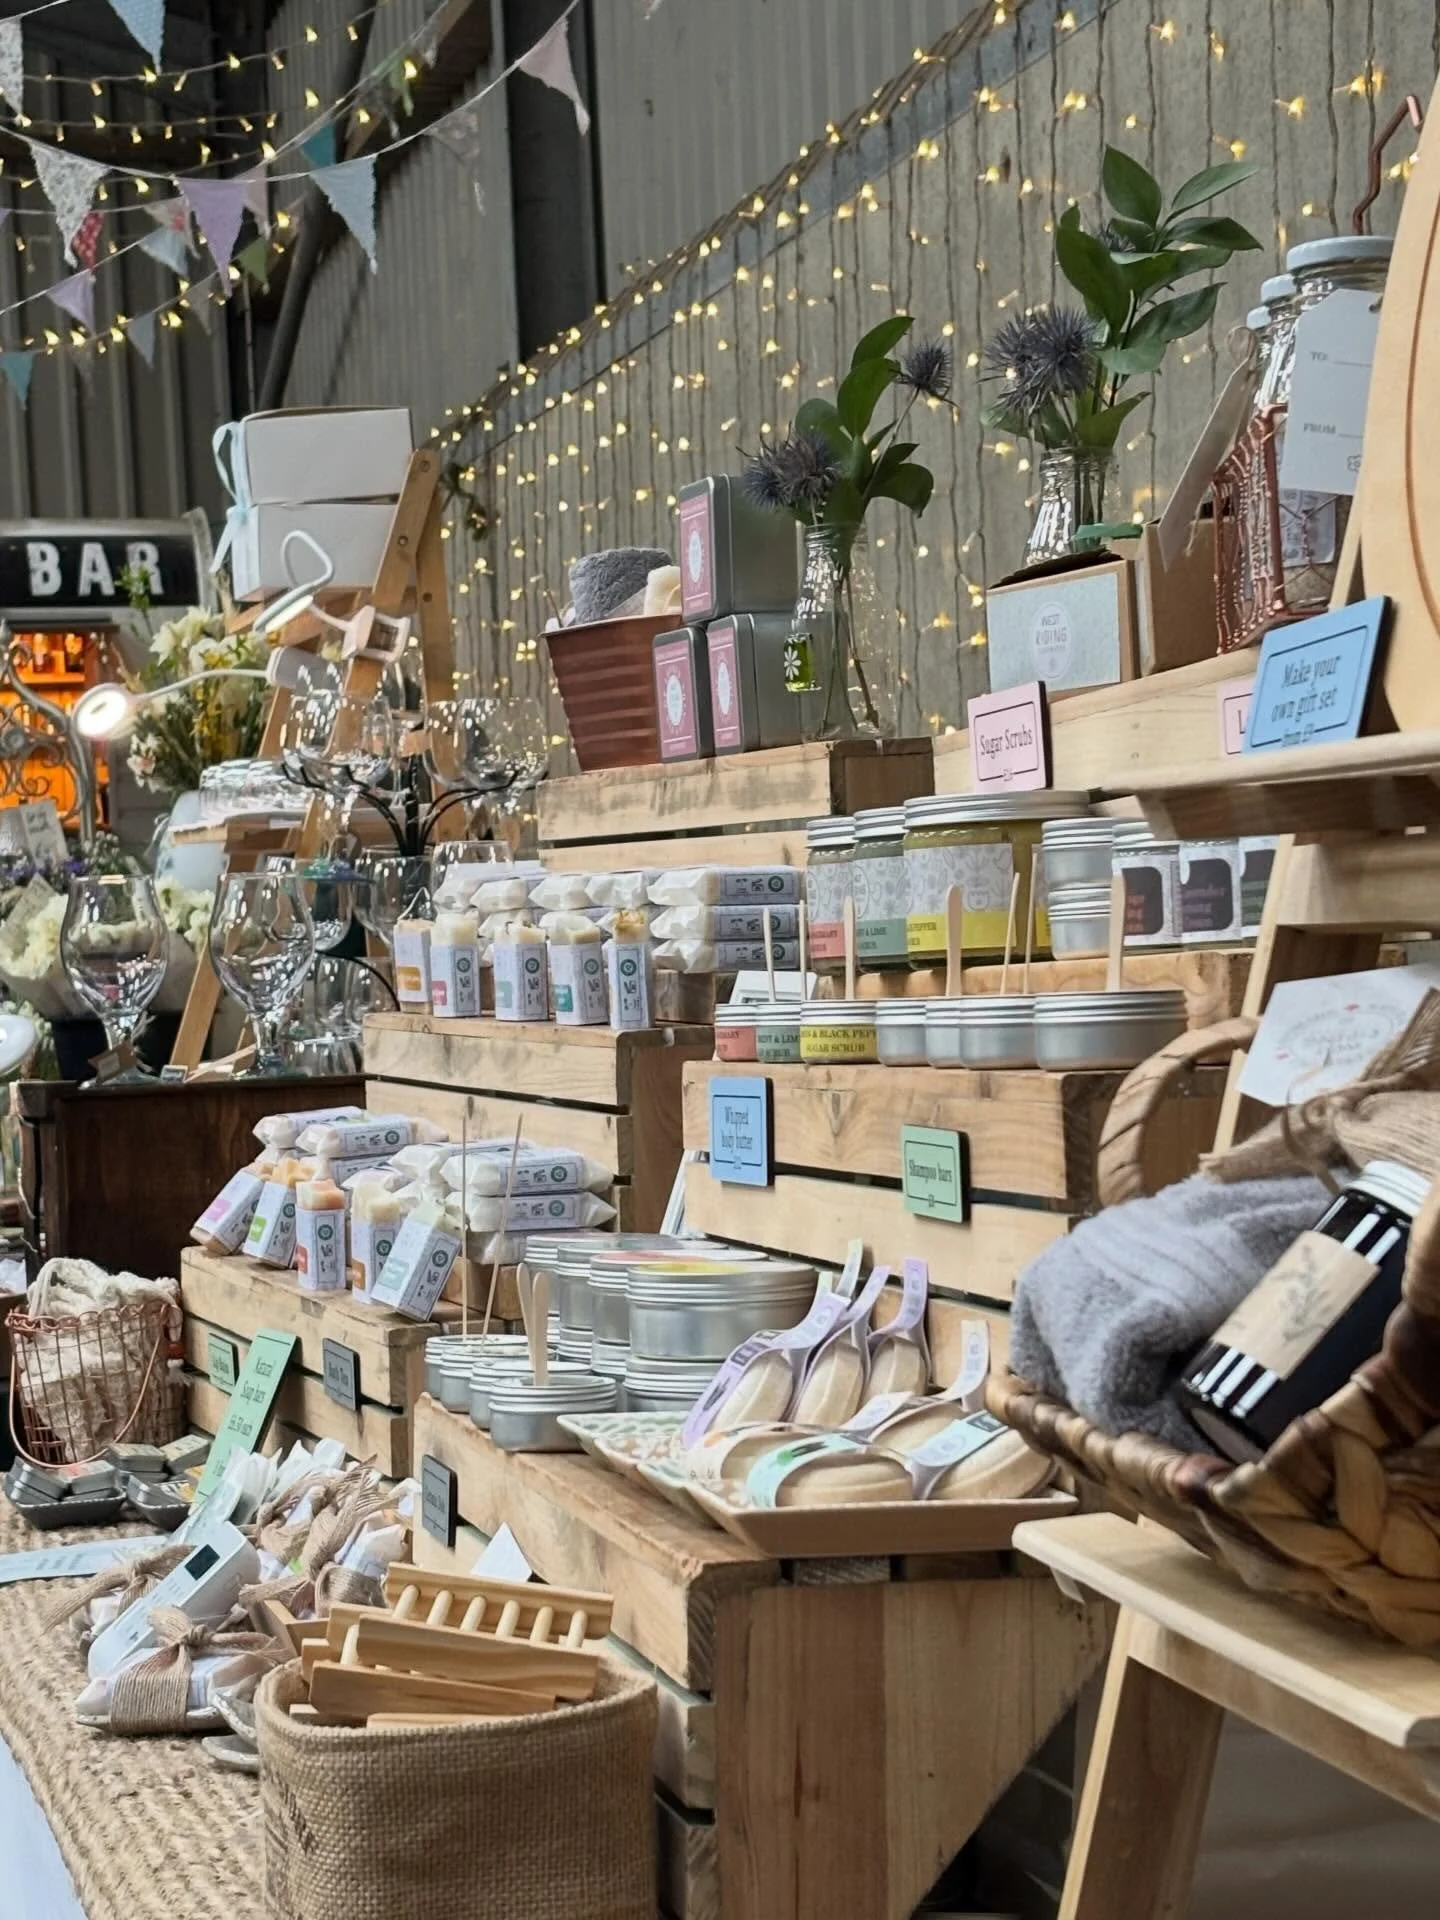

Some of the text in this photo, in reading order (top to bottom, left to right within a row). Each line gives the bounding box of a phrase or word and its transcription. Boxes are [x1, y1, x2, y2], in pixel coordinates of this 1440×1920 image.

[1303, 422, 1337, 435] FROM
[26, 541, 164, 597] BAR
[1284, 655, 1341, 690] Make your
[1271, 701, 1295, 722] own
[1318, 687, 1338, 711] set
[980, 724, 1033, 759] Sugar Scrubs
[820, 1029, 850, 1039] BLACK
[831, 1043, 865, 1053] SCRUB
[909, 1159, 953, 1184] Shampoo bars
